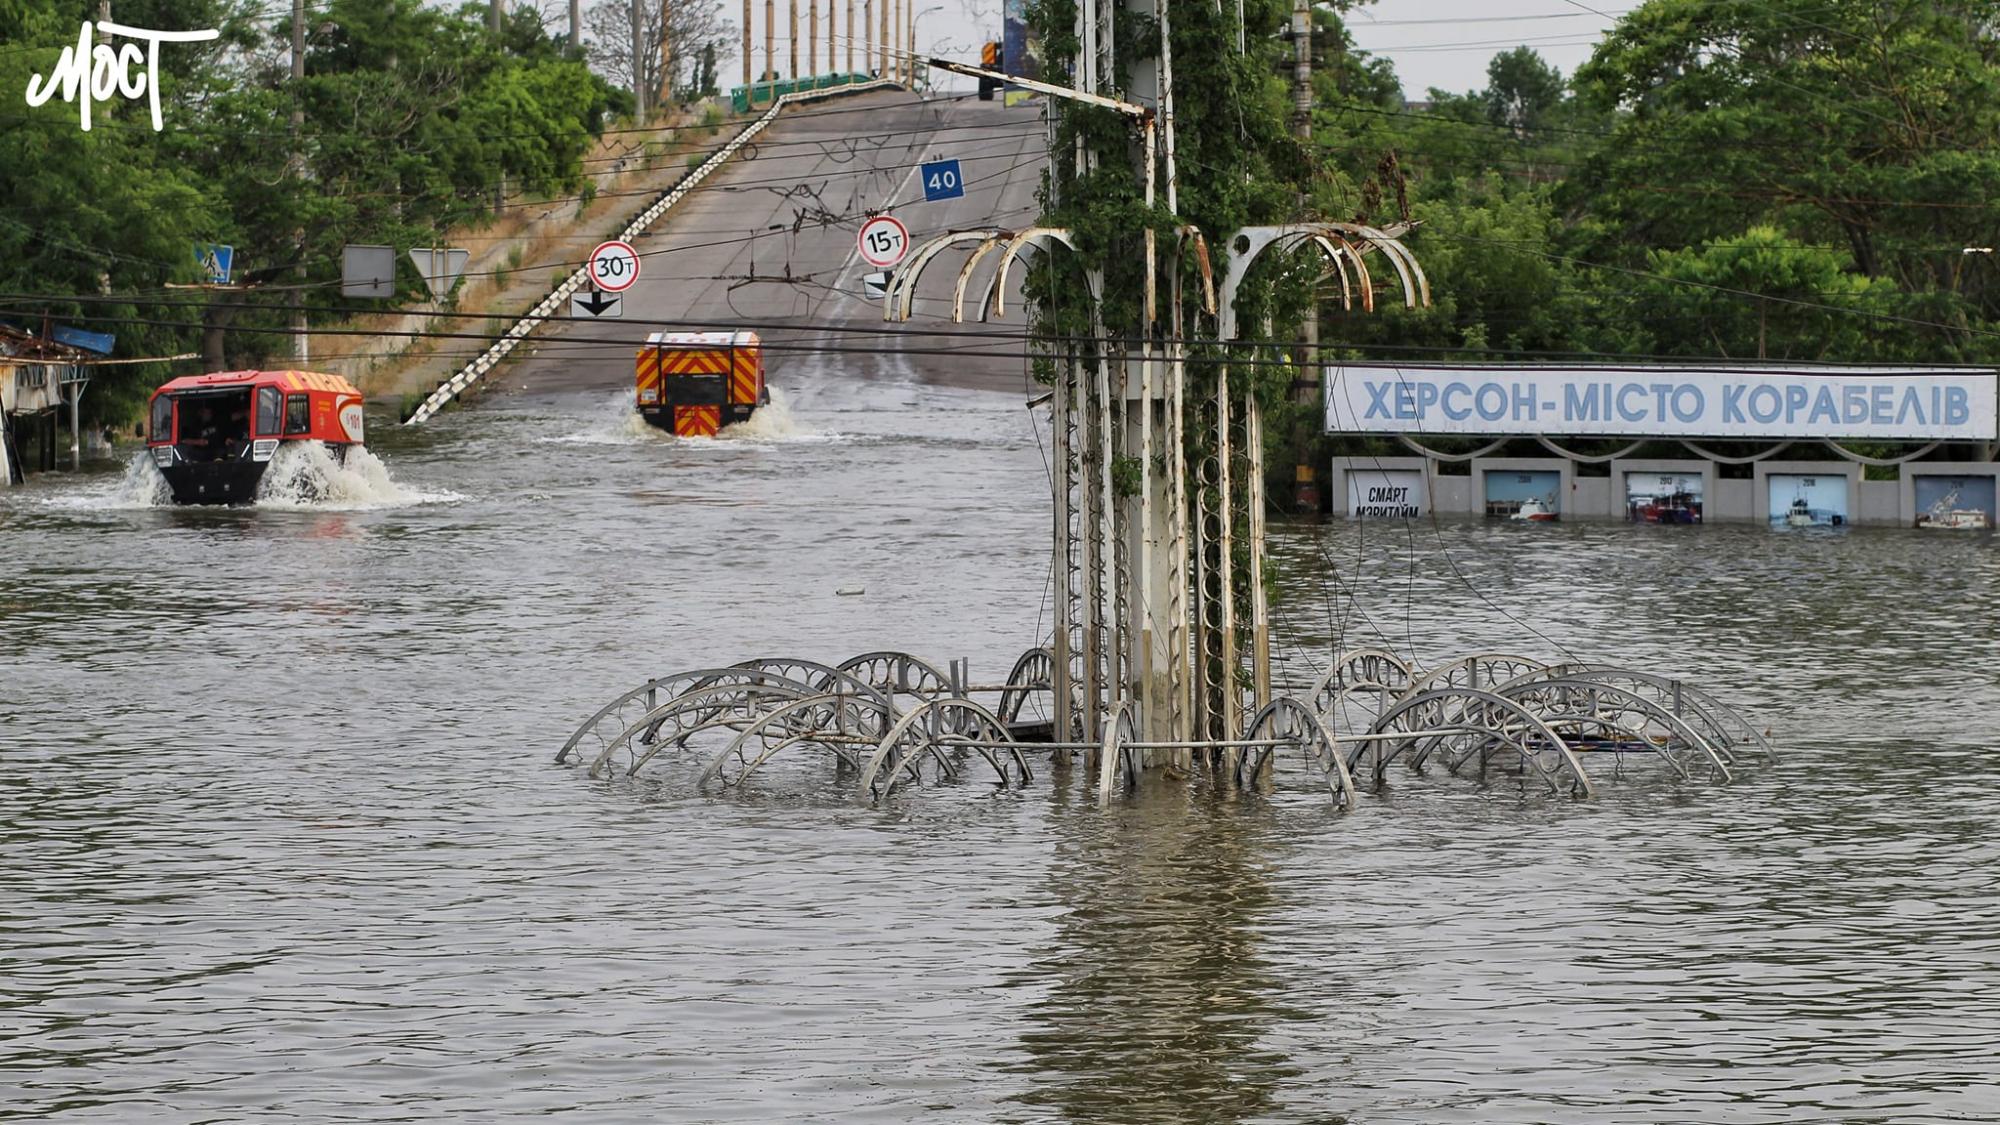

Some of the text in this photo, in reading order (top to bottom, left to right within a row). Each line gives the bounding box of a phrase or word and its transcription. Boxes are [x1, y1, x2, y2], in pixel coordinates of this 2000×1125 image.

[928, 171, 956, 190] 40
[1722, 384, 1970, 426] КОРАБЕЛІВ
[1368, 487, 1408, 503] СМАРТ
